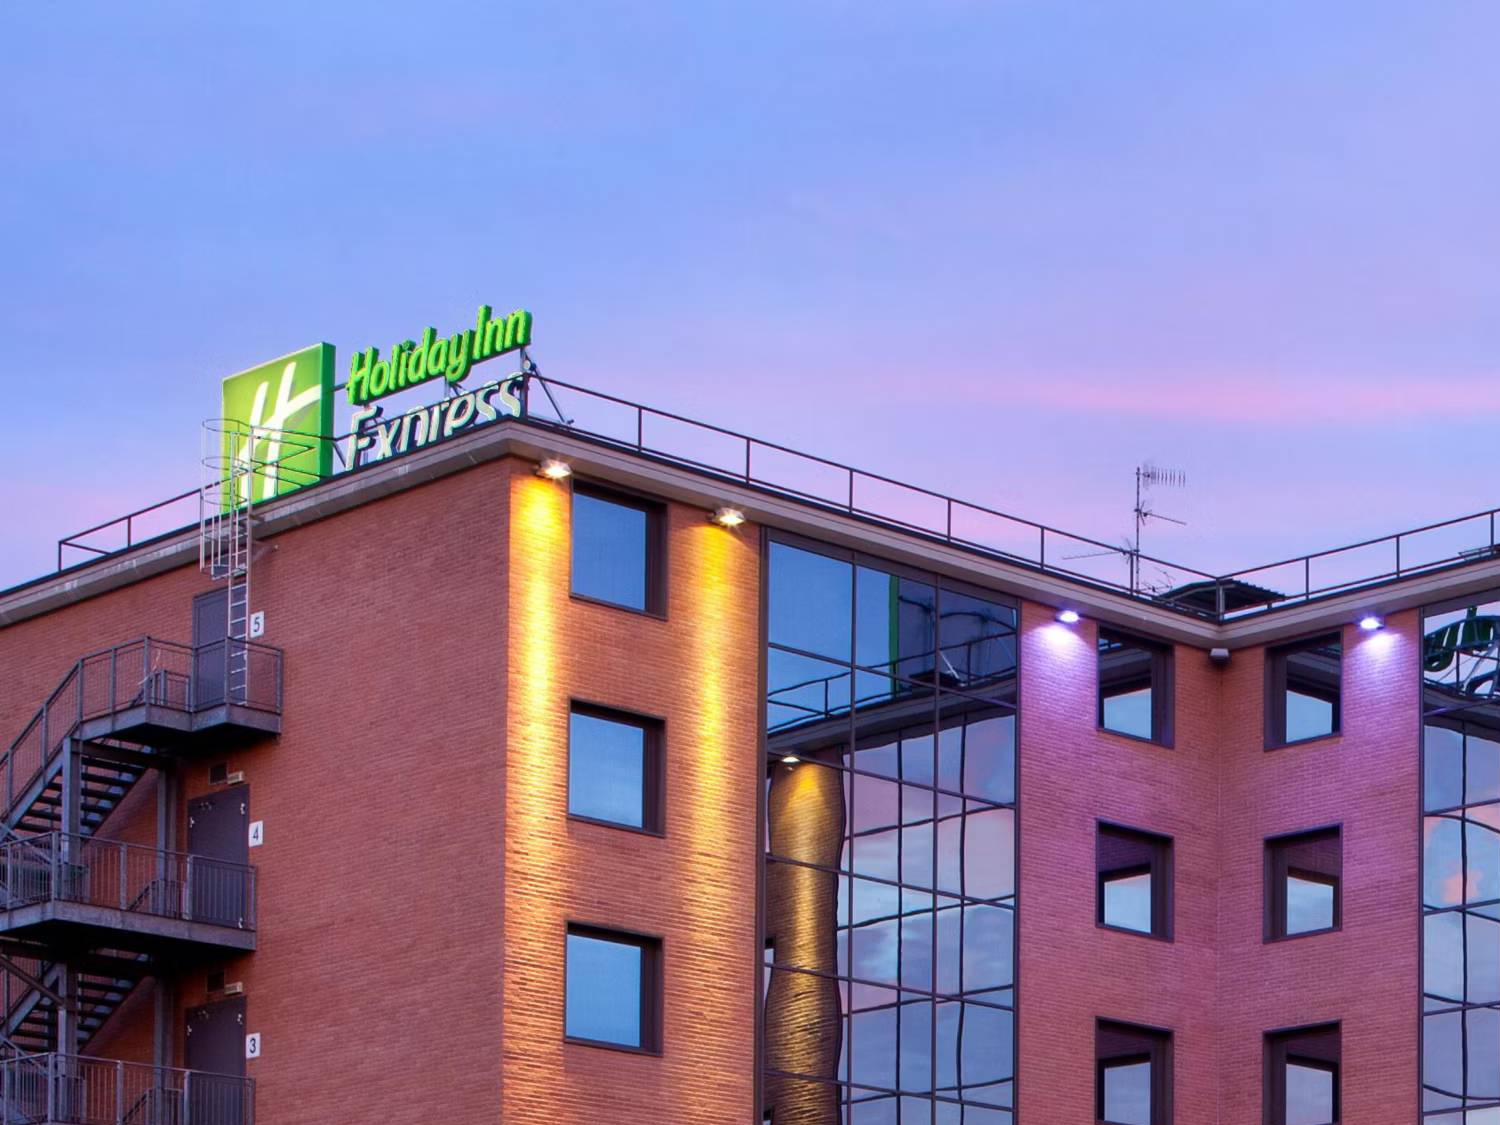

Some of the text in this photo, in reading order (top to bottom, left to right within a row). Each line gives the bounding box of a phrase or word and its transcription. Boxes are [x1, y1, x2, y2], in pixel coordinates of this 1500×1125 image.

[253, 615, 261, 634] 5
[252, 823, 260, 841] 4
[249, 1036, 257, 1055] 3
